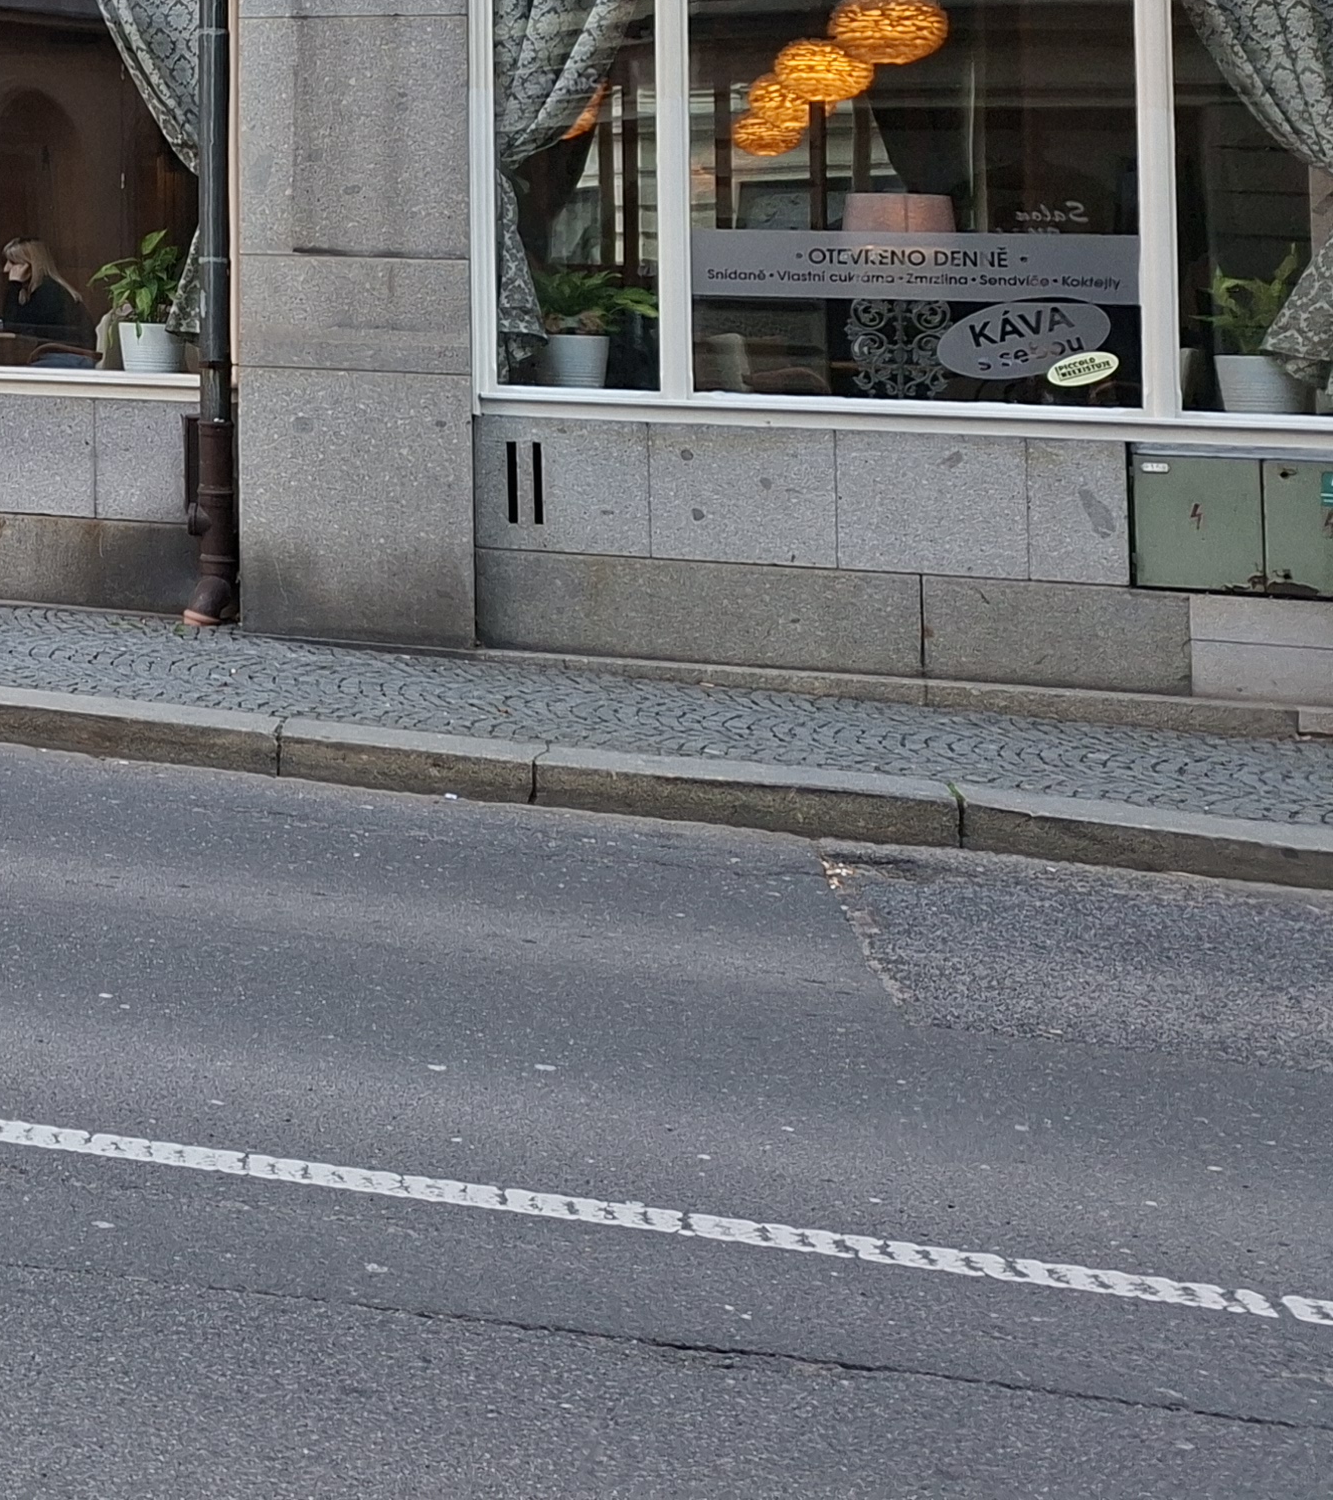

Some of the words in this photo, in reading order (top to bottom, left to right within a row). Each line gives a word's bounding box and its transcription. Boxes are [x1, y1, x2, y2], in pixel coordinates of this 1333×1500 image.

[933, 246, 1009, 268] DENNĚ
[706, 267, 767, 282] Snídaně
[776, 269, 826, 283] Vlastní
[905, 272, 969, 286] Zmrzlina
[1061, 275, 1121, 290] Koktejly
[968, 306, 1076, 348] KÁVA
[1058, 356, 1096, 372] PICCOLO
